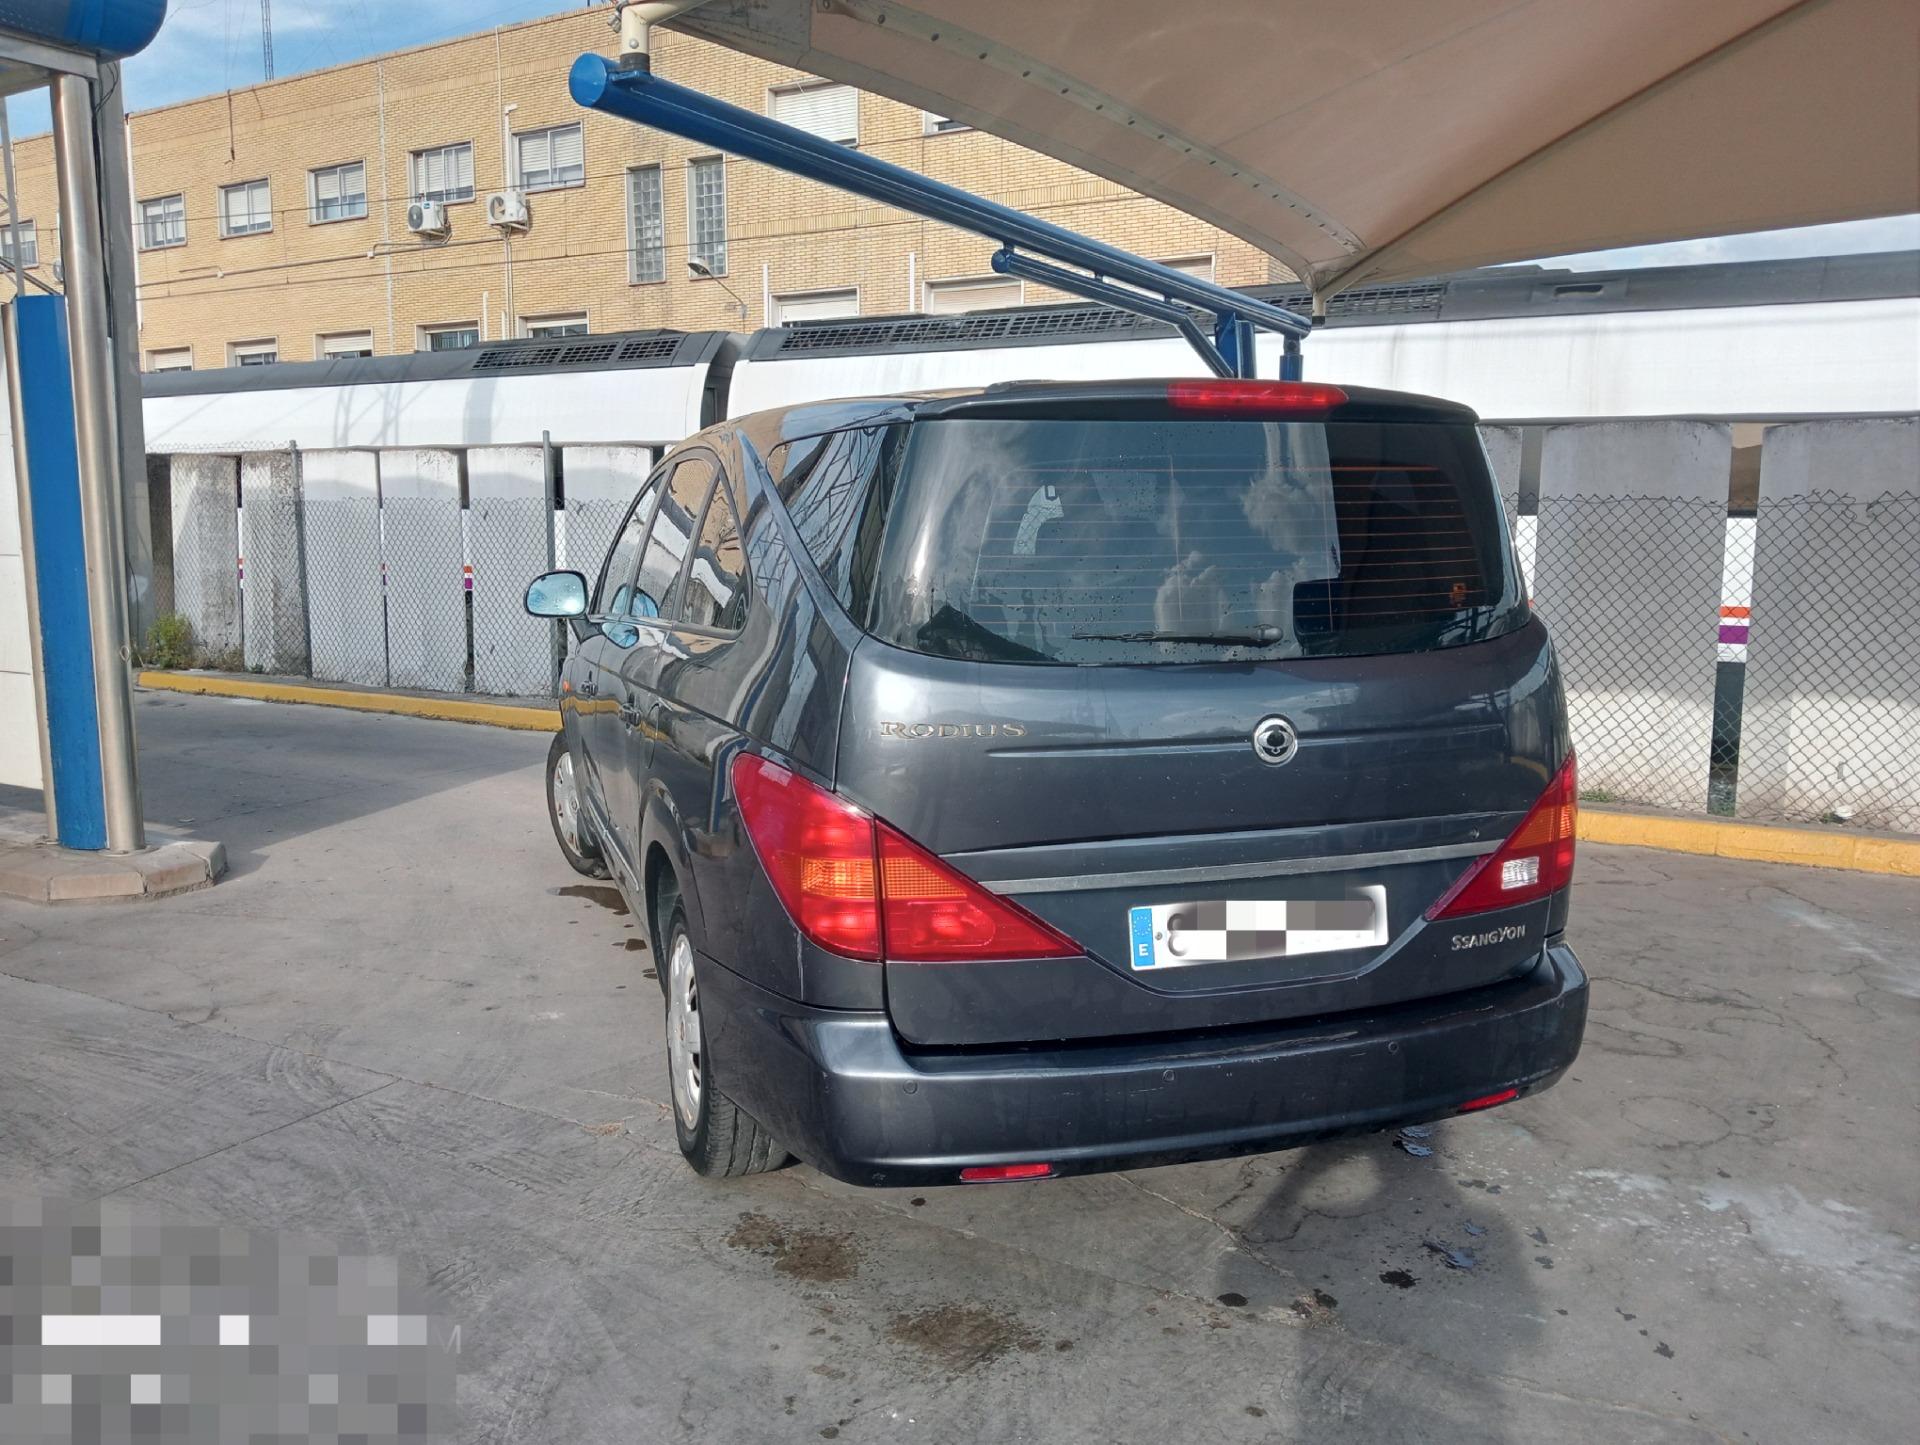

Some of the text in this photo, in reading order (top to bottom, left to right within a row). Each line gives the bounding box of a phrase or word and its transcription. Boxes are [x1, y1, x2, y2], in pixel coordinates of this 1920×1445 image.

[880, 721, 1028, 739] RODIUS
[1451, 924, 1526, 951] SSANGYON
[1138, 943, 1149, 956] E
